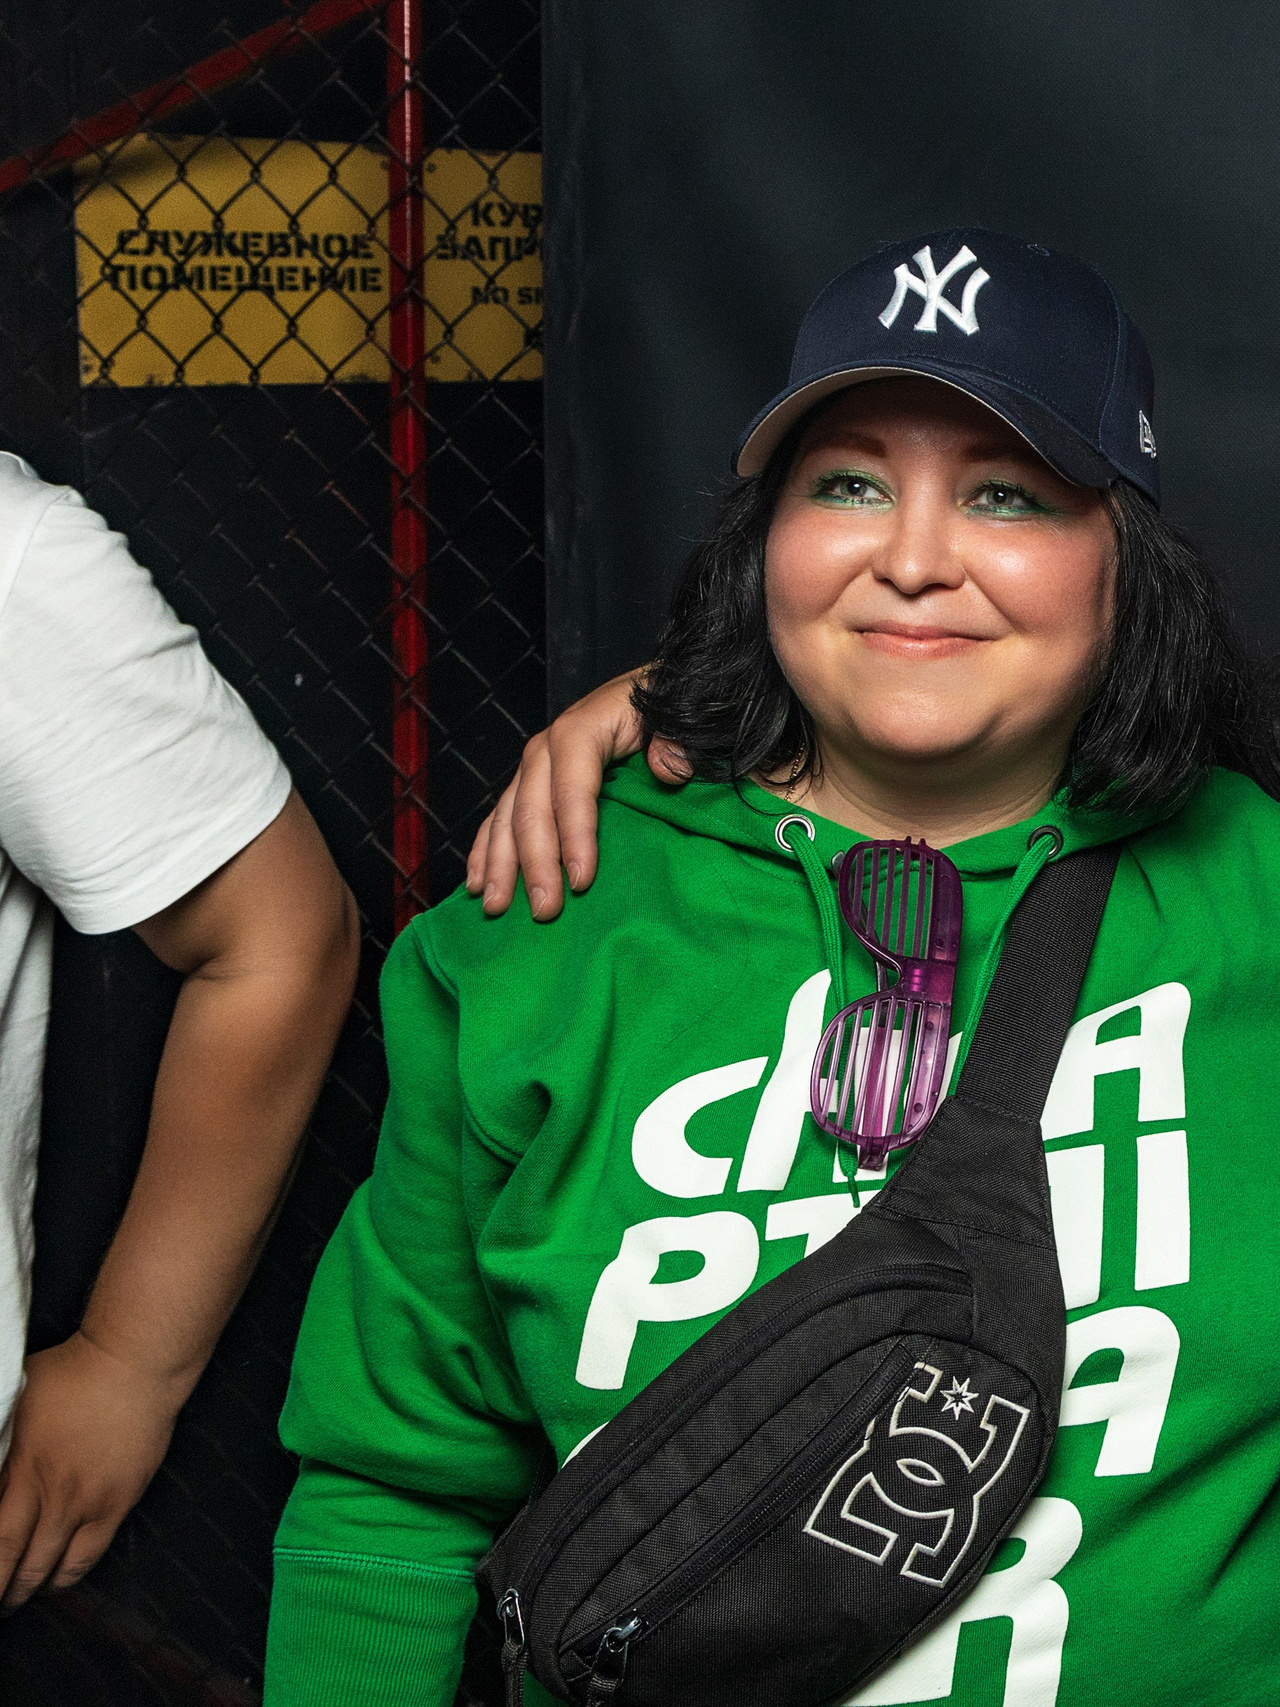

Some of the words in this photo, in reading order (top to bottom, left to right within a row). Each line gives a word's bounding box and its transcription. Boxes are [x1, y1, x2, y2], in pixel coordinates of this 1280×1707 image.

[116, 230, 375, 259] СЛУЖЕБНОЕ
[436, 236, 543, 261] ЗАПР
[109, 265, 383, 297] ПОМЕЩЕНИЕ
[471, 286, 510, 304] NO
[877, 245, 991, 335] NY
[802, 1361, 1031, 1589] DC
